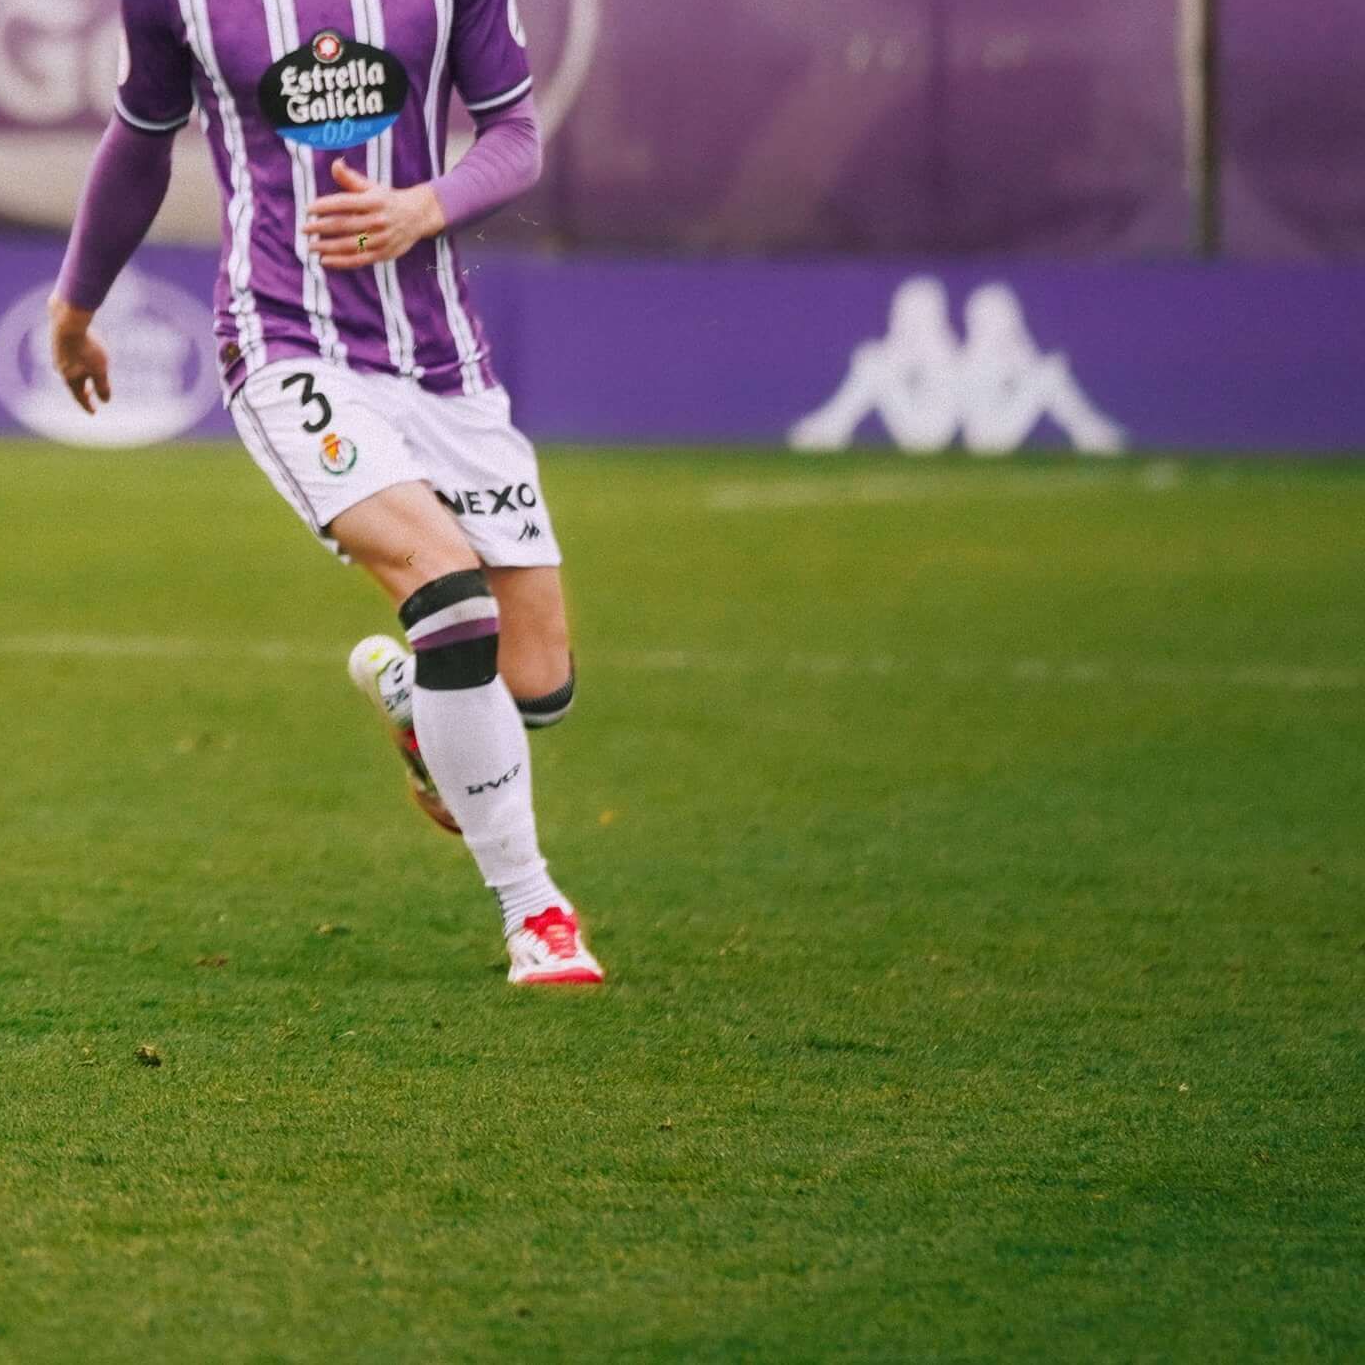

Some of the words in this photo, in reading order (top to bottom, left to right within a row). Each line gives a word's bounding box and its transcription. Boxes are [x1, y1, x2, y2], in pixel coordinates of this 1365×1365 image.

[280, 57, 387, 97] Estrella
[285, 84, 385, 124] Galicia
[281, 372, 332, 433] 3
[433, 482, 537, 516] NEXO
